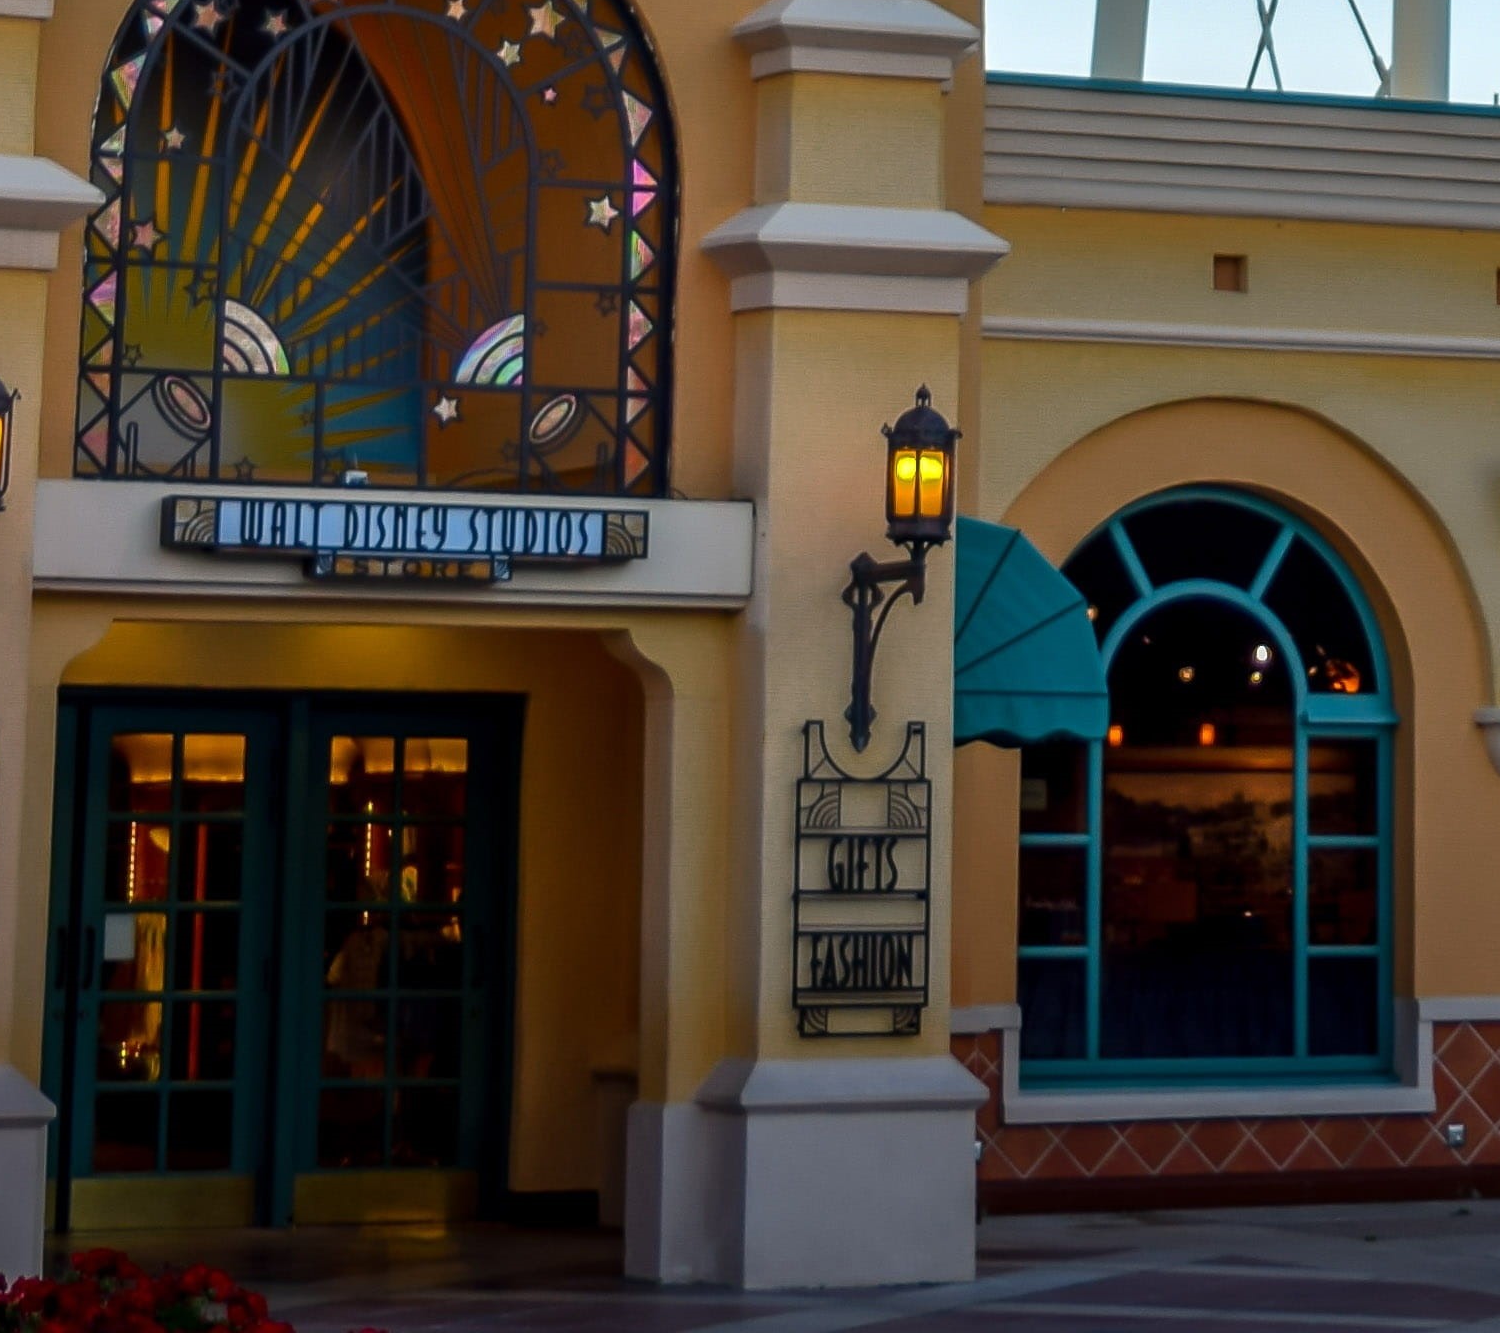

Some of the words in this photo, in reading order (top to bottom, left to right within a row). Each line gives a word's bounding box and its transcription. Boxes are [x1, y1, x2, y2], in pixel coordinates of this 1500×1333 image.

[239, 499, 325, 547] WALT
[343, 504, 449, 550] DISNEY
[469, 509, 591, 555] STUDIOS
[826, 835, 899, 891] GIFTS
[809, 934, 914, 989] FASHION
